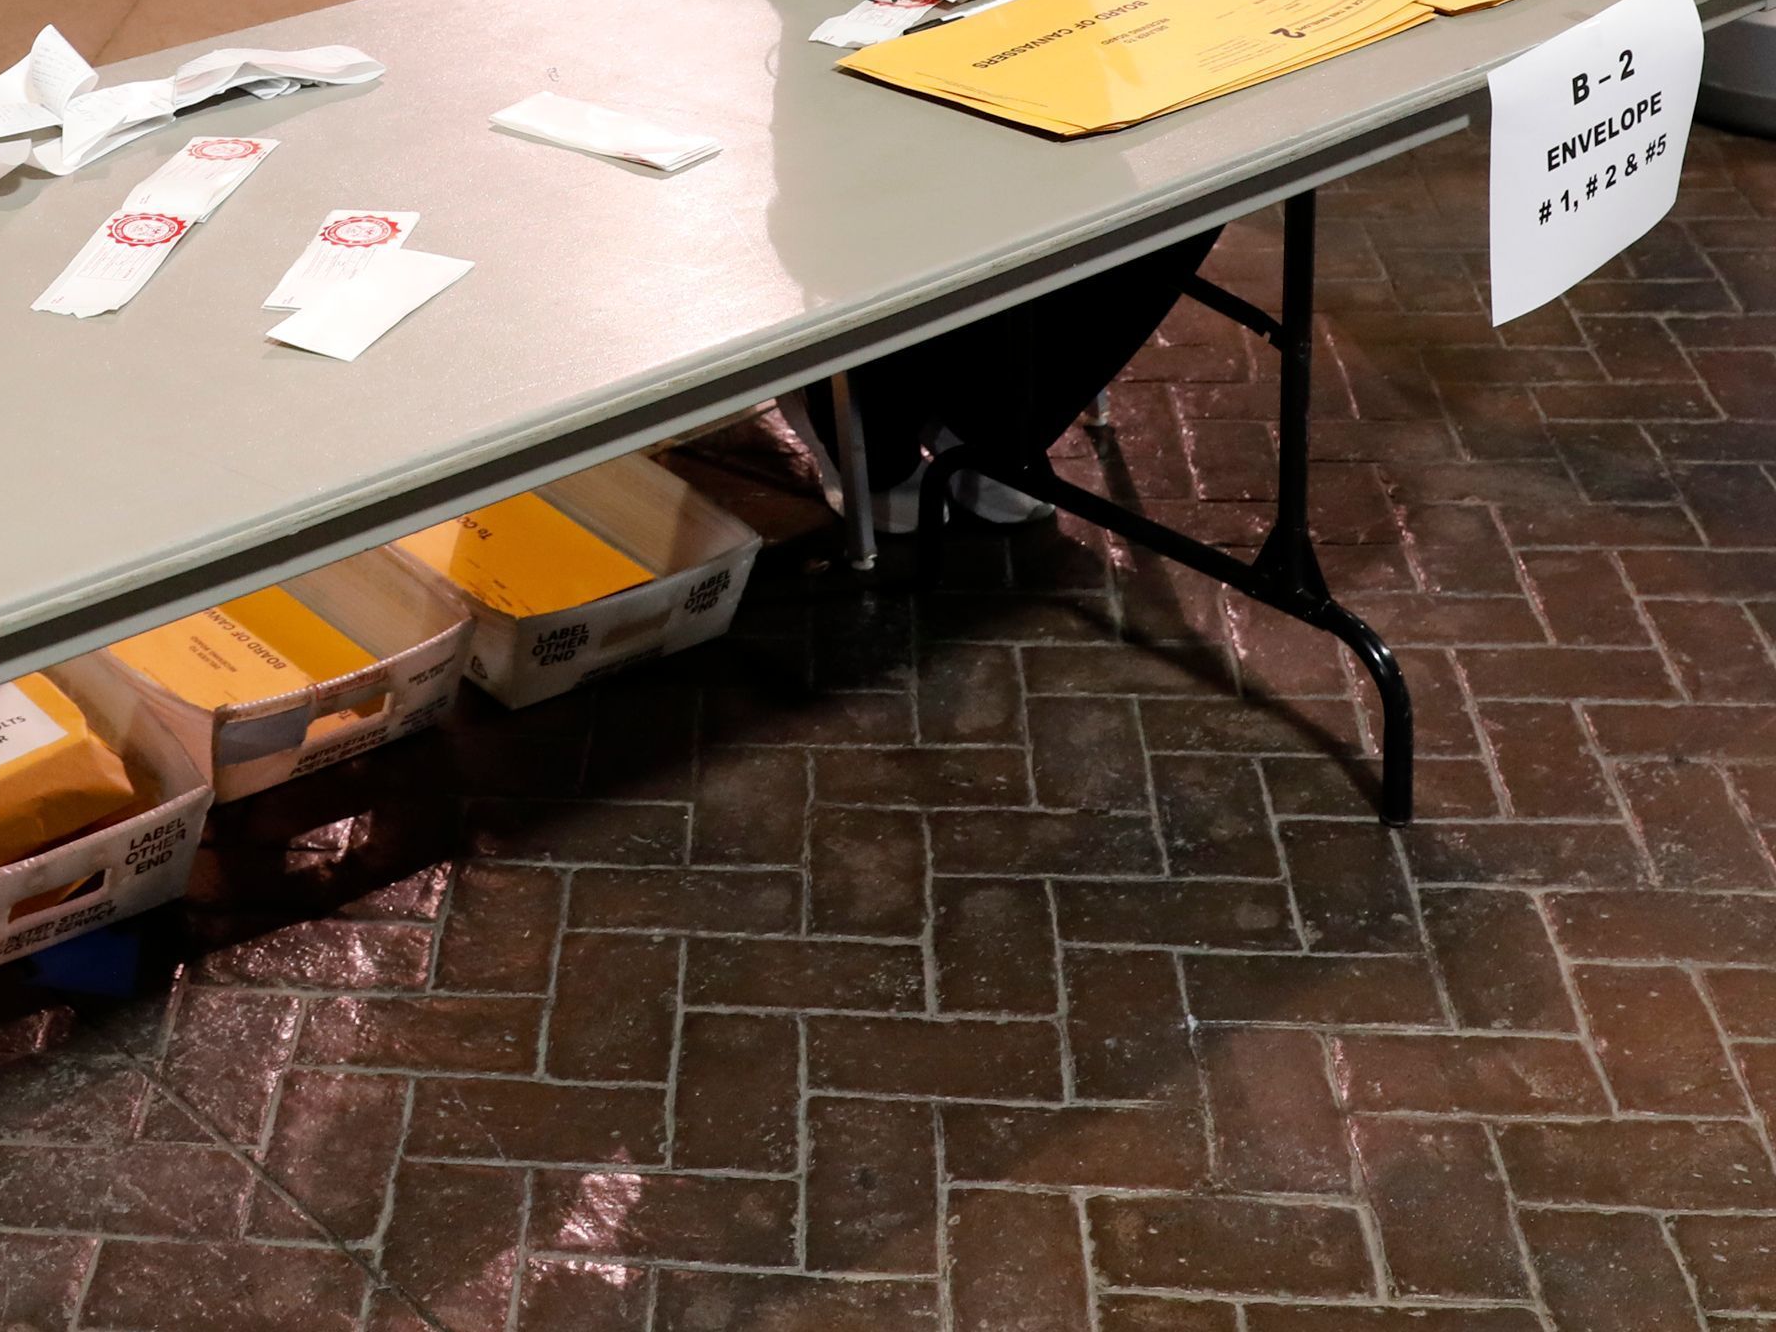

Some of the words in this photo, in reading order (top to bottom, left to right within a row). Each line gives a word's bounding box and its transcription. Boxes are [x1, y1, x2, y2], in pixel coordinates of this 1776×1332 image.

[1074, 18, 1096, 30] OF
[1095, 0, 1148, 21] BOARD
[972, 28, 1074, 69] CANVASSERS
[1573, 74, 1589, 105] B
[1620, 50, 1634, 80] 2
[1548, 92, 1661, 171] ENVELOPE
[1539, 200, 1551, 225] #
[1561, 190, 1579, 212] 1,
[1586, 175, 1598, 199] #
[1606, 165, 1617, 188] 2
[1625, 154, 1638, 176] &
[1646, 134, 1667, 164] #5
[456, 515, 479, 529] CO
[684, 580, 730, 611] OTHER
[689, 569, 731, 599] LABEL
[204, 609, 236, 631] CANV
[538, 623, 590, 644] LABEL
[231, 631, 250, 642] OF
[532, 634, 590, 659] OTHER
[247, 642, 288, 670] BOARD
[540, 648, 577, 667] END
[343, 726, 389, 748] STATES
[125, 829, 187, 866] OTHER
[129, 818, 186, 851] LABEL
[135, 850, 173, 875] END
[0, 923, 55, 947] UNITED
[59, 899, 114, 924] STATES
[54, 906, 117, 937] SERVICE
